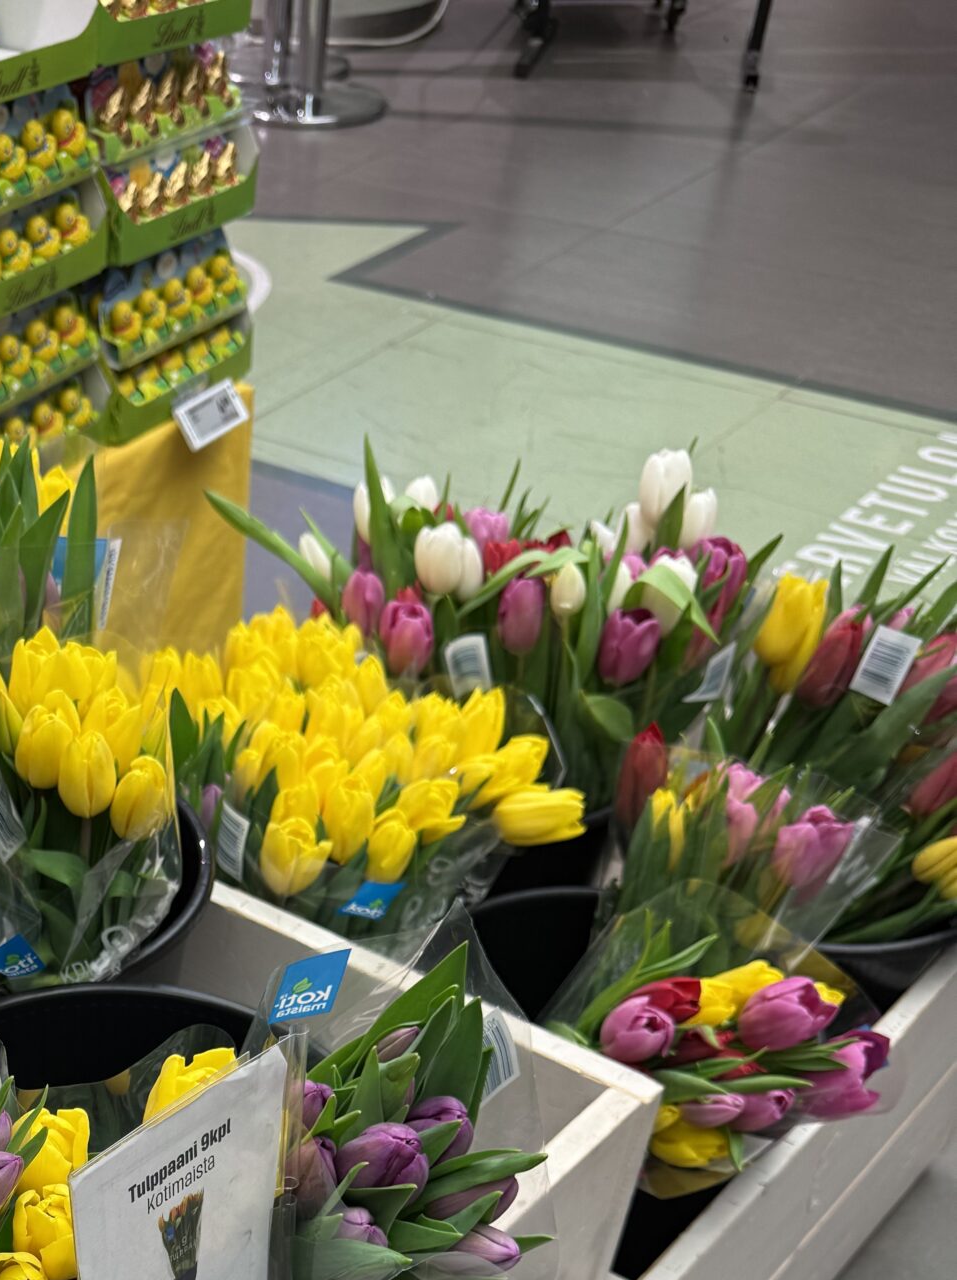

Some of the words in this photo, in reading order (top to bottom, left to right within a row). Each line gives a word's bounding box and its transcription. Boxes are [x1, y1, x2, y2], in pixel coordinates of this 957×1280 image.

[778, 430, 957, 590] RVETULO
[128, 1141, 198, 1203] Tulppaani
[200, 1118, 231, 1152] 9kpl
[147, 1155, 215, 1215] Kotimaista
